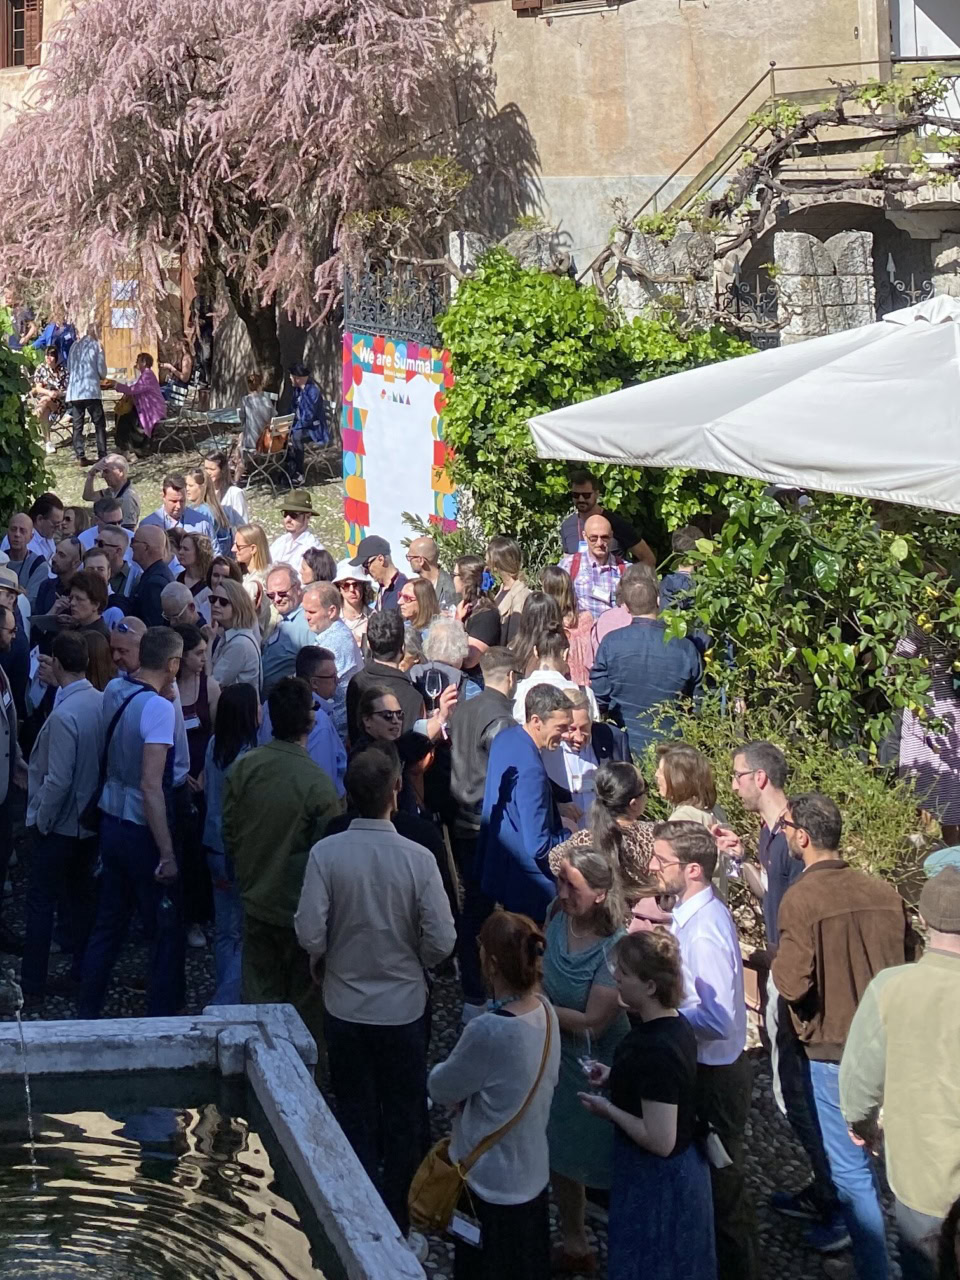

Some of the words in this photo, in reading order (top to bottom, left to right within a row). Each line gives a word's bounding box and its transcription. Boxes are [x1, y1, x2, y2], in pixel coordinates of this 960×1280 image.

[360, 347, 375, 364] We
[376, 353, 391, 367] are
[394, 352, 434, 374] Summa!
